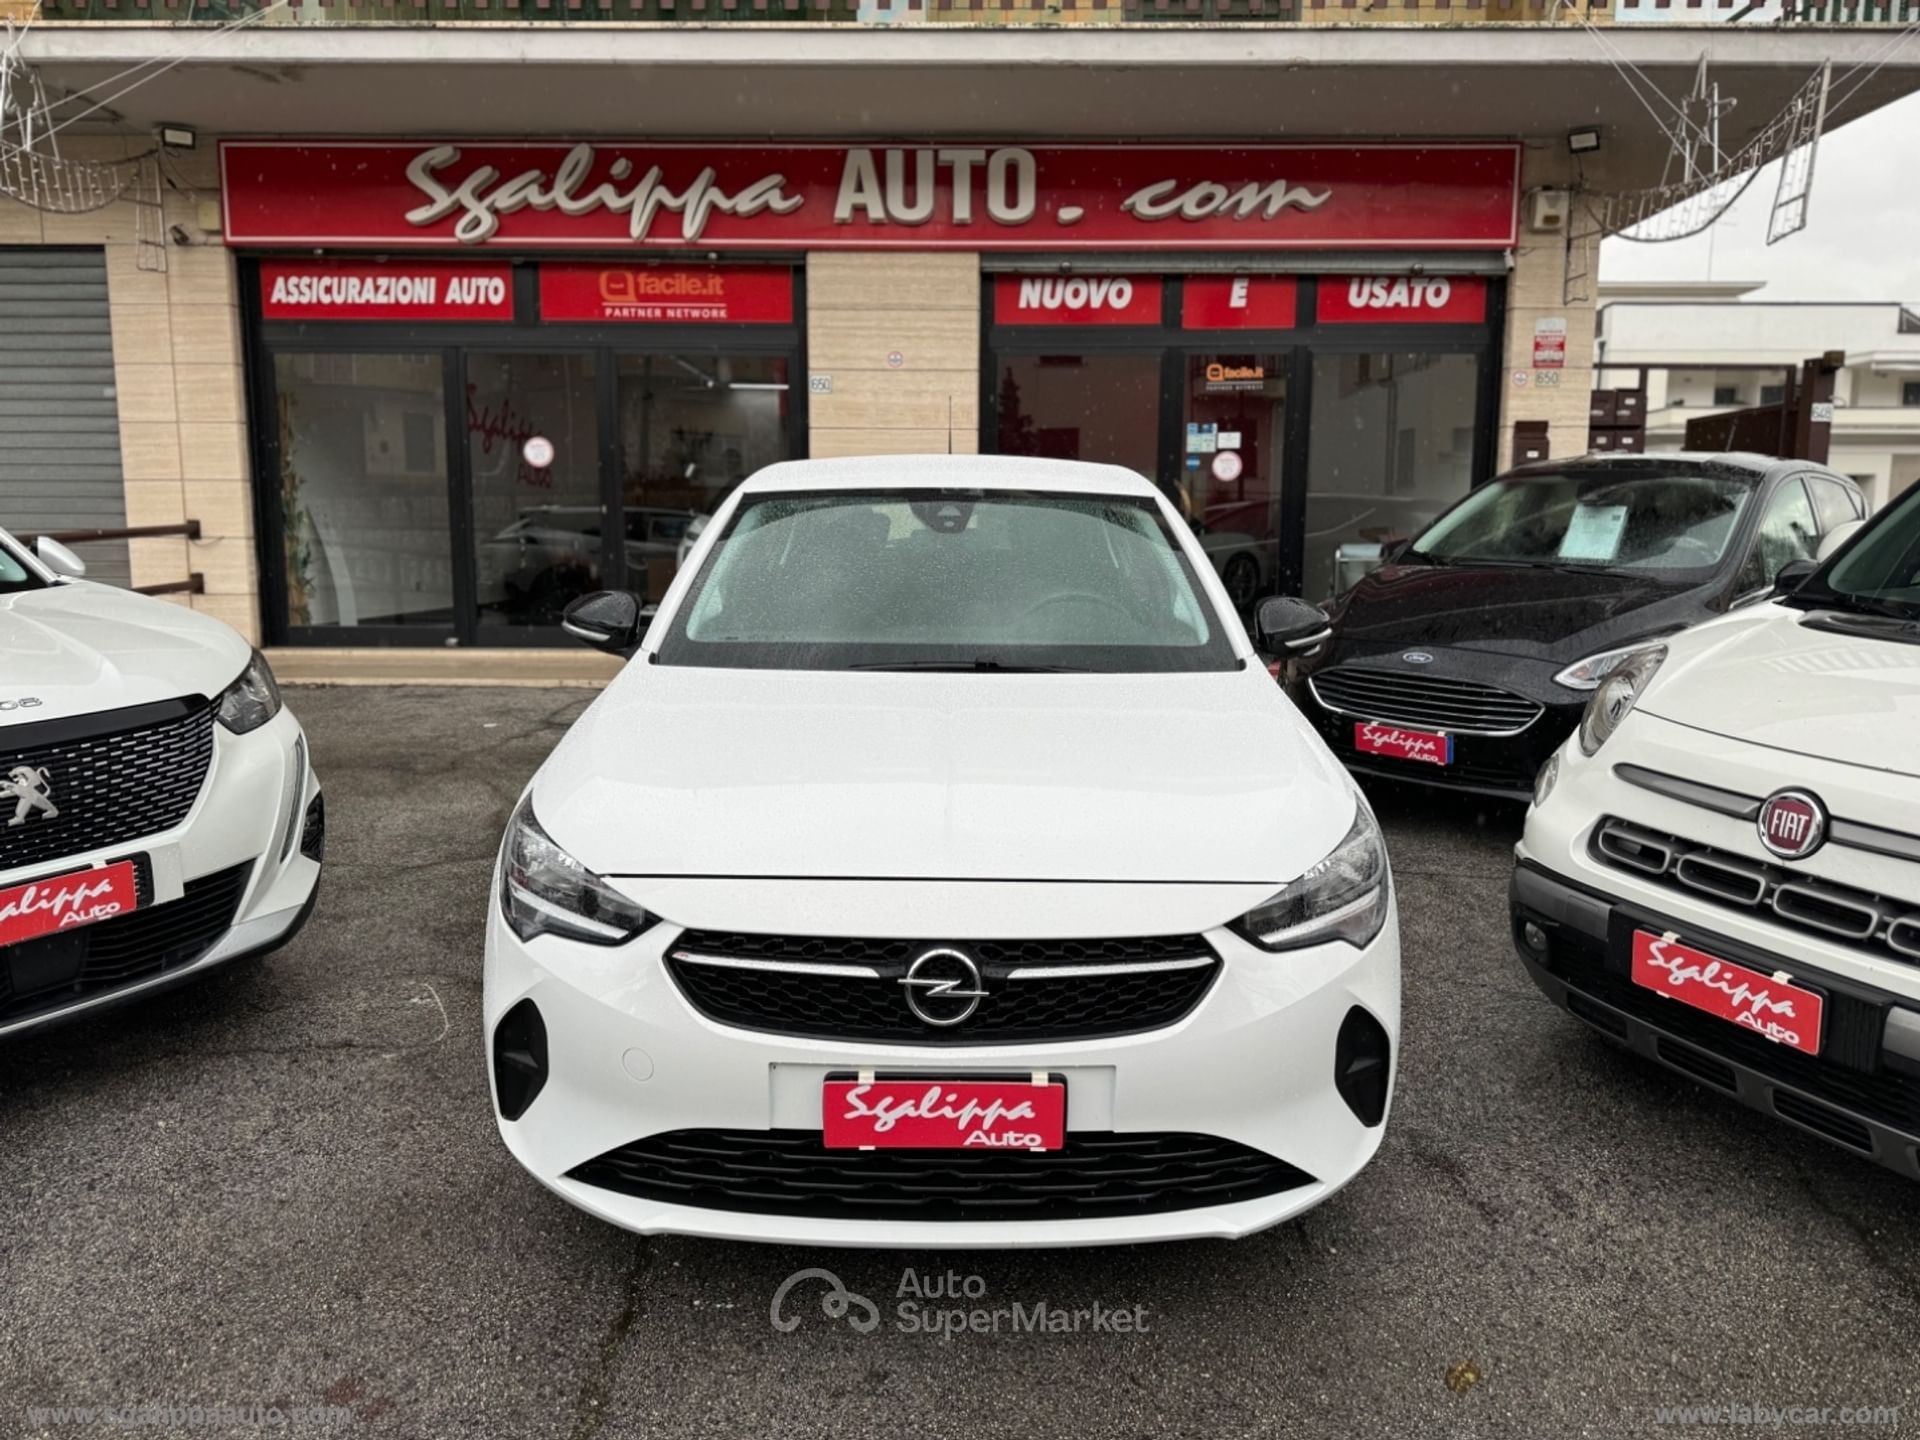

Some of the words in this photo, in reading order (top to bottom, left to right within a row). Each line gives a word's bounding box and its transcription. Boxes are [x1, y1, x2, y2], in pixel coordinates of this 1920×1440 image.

[404, 144, 804, 244] Sgalippa
[833, 147, 1037, 225] AUTO
[271, 276, 437, 304] ASSICURAZIONI
[445, 276, 505, 305] AUTO
[637, 272, 725, 296] facile.it
[1018, 278, 1133, 309] NUOVO
[1229, 278, 1249, 308] E
[1348, 277, 1451, 308] USATO
[604, 307, 662, 318] PARTNER
[666, 308, 728, 319] NETWORK
[1536, 371, 1560, 385] 650
[1362, 725, 1436, 750] Sgalippa
[1770, 808, 1809, 841] FIAT
[1647, 941, 1796, 1018] Sgalippa
[844, 1085, 1036, 1132] Sgalippa
[963, 1130, 1042, 1147] Auto
